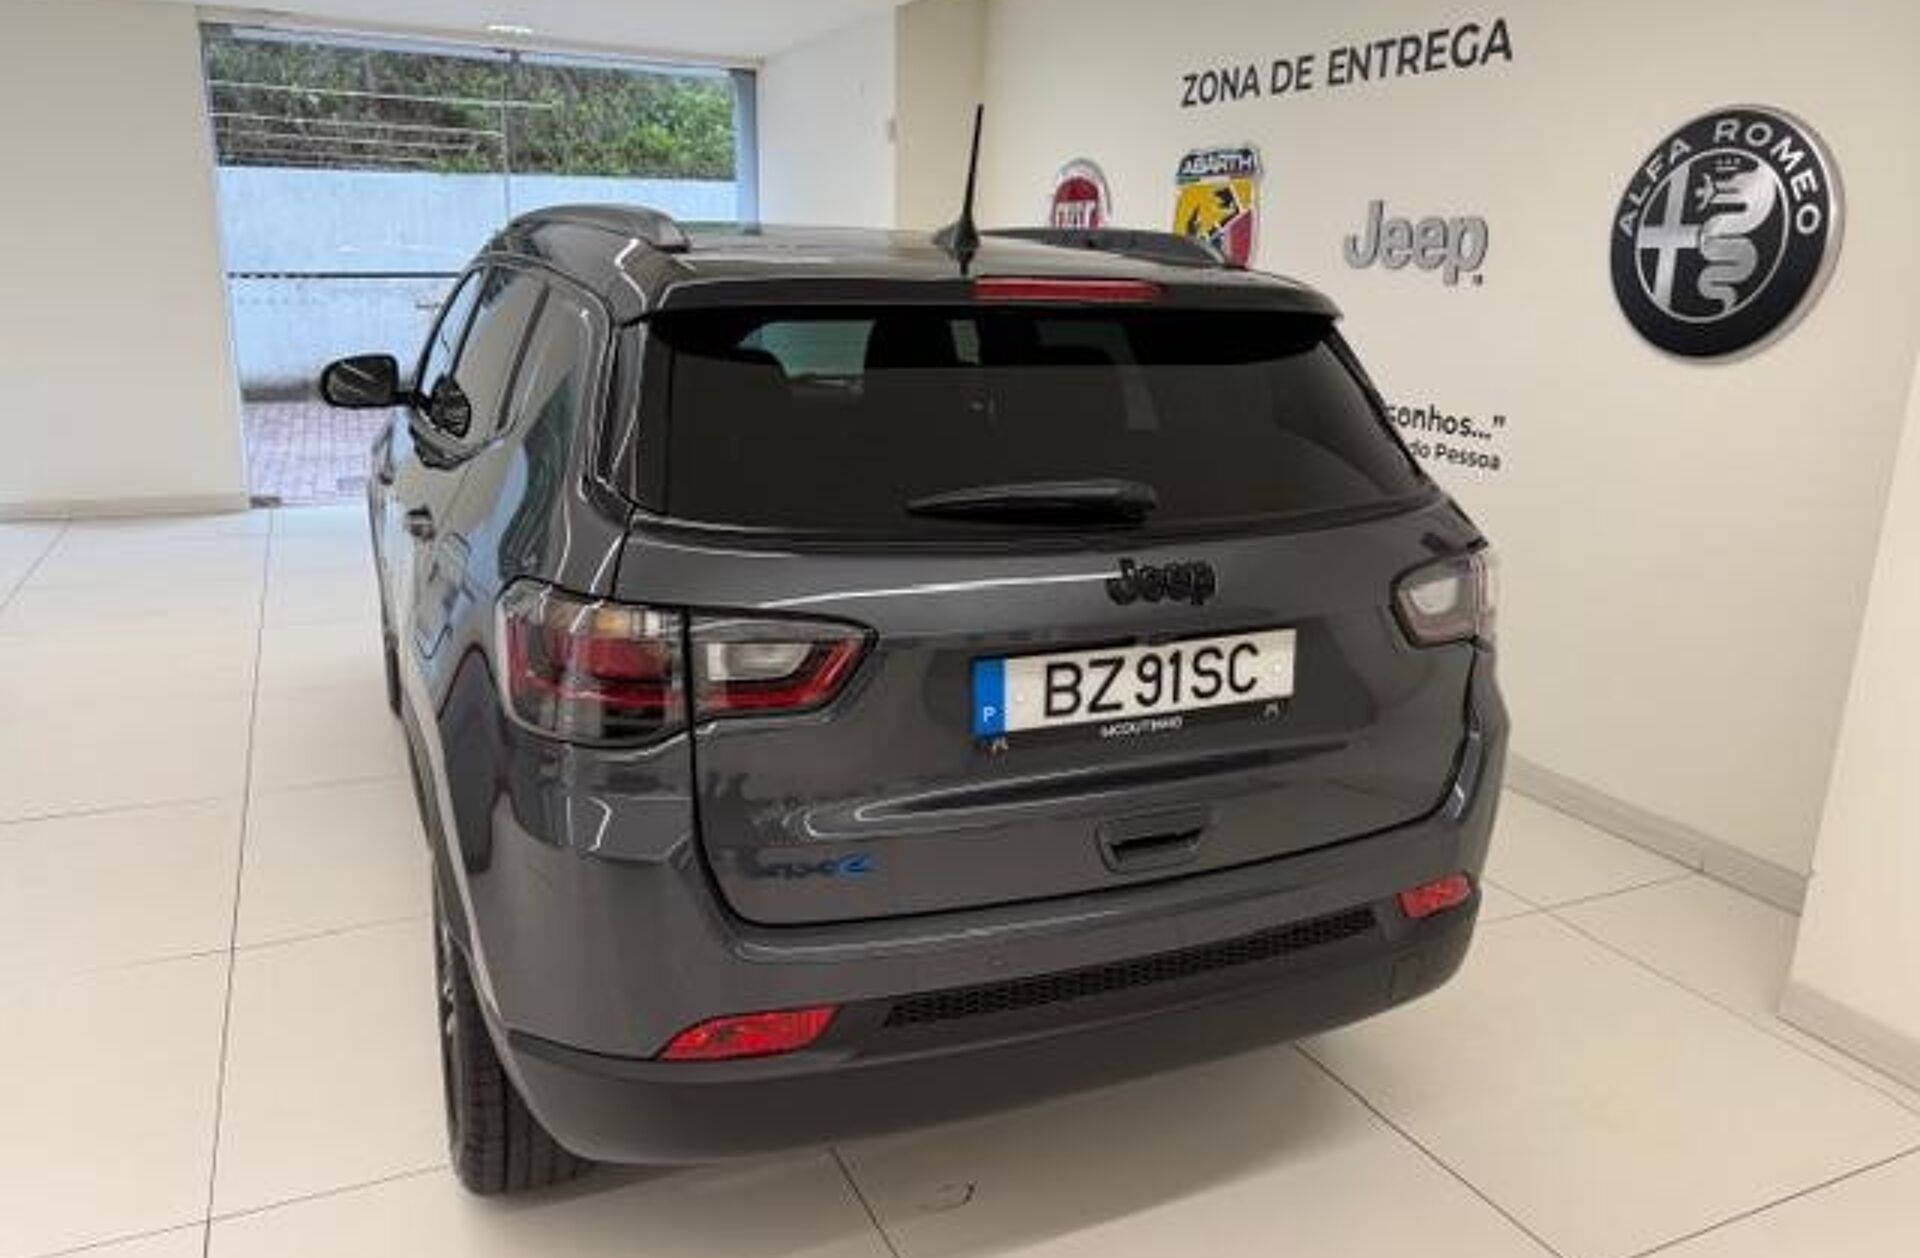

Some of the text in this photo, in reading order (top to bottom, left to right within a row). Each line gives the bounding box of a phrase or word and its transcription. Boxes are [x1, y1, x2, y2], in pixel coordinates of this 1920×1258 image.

[1180, 17, 1514, 108] ZONA DE ENTREGA
[1182, 153, 1252, 176] ABARTH
[1618, 117, 1822, 238] ALFA ROMEO
[1343, 199, 1489, 287] Jeep
[1435, 442, 1501, 471] Pessoa
[1105, 557, 1216, 606] Jeep
[982, 706, 997, 723] P
